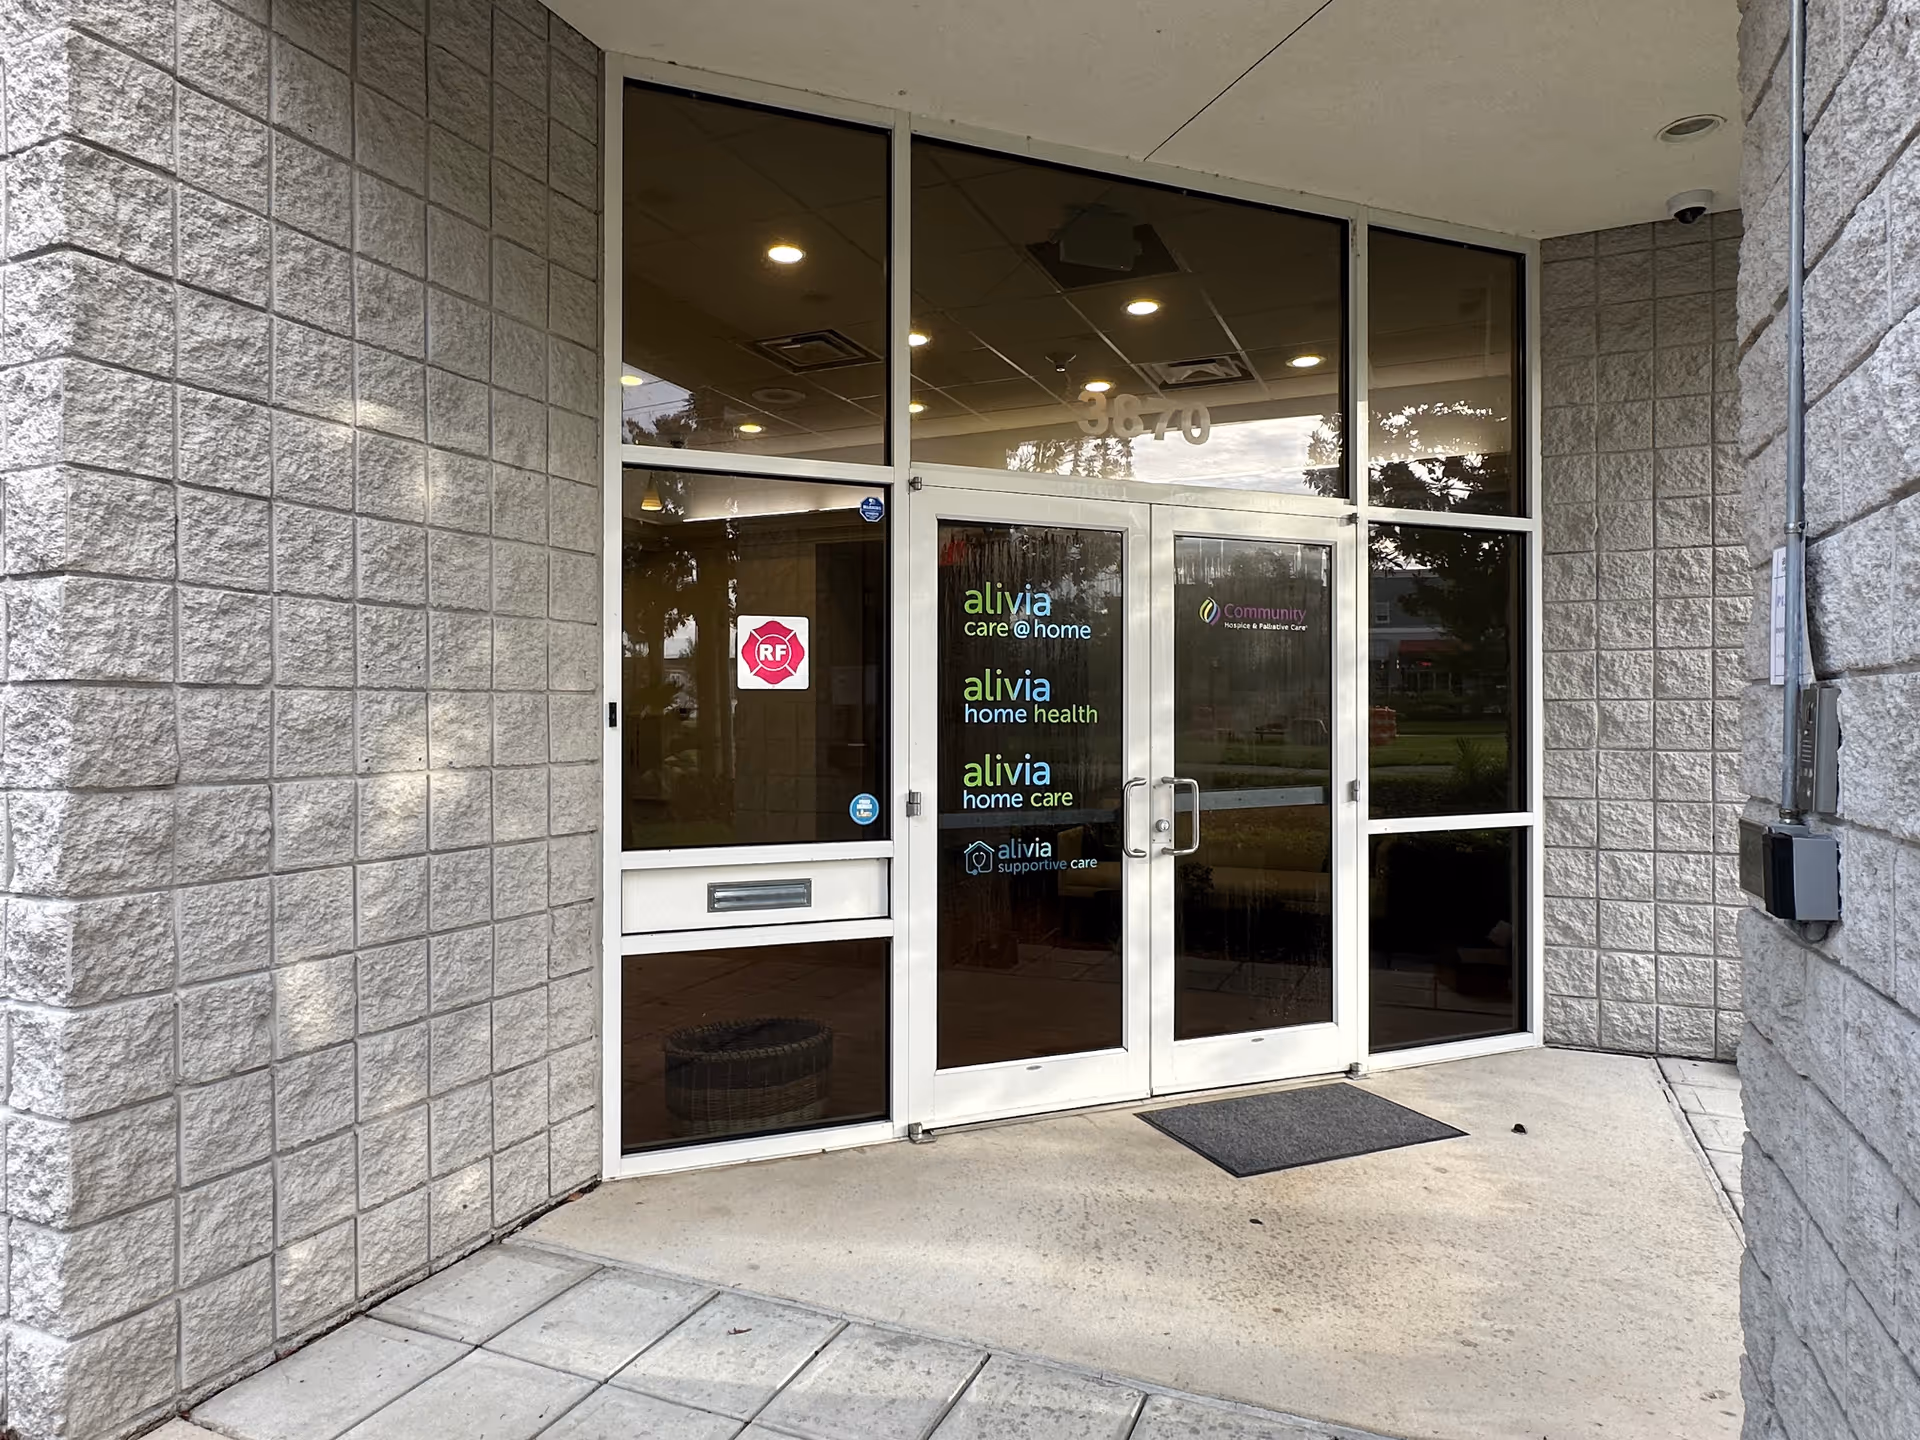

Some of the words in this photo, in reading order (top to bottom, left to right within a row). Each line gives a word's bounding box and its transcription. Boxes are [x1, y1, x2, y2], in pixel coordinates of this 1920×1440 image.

[1078, 391, 1210, 445] 3870
[964, 582, 1051, 616] alivia
[1224, 603, 1306, 624] Community
[964, 621, 1009, 637] care
[1224, 622, 1250, 630] Hospice
[760, 644, 787, 661] RF
[963, 669, 1051, 702] alivia
[965, 704, 1027, 723] home
[1034, 704, 1098, 723] health
[963, 754, 1051, 787] alivia
[964, 790, 1023, 809] home
[1030, 792, 1073, 807] care
[998, 837, 1052, 859] alivia
[998, 859, 1067, 875] supportive
[1070, 858, 1098, 869] care
